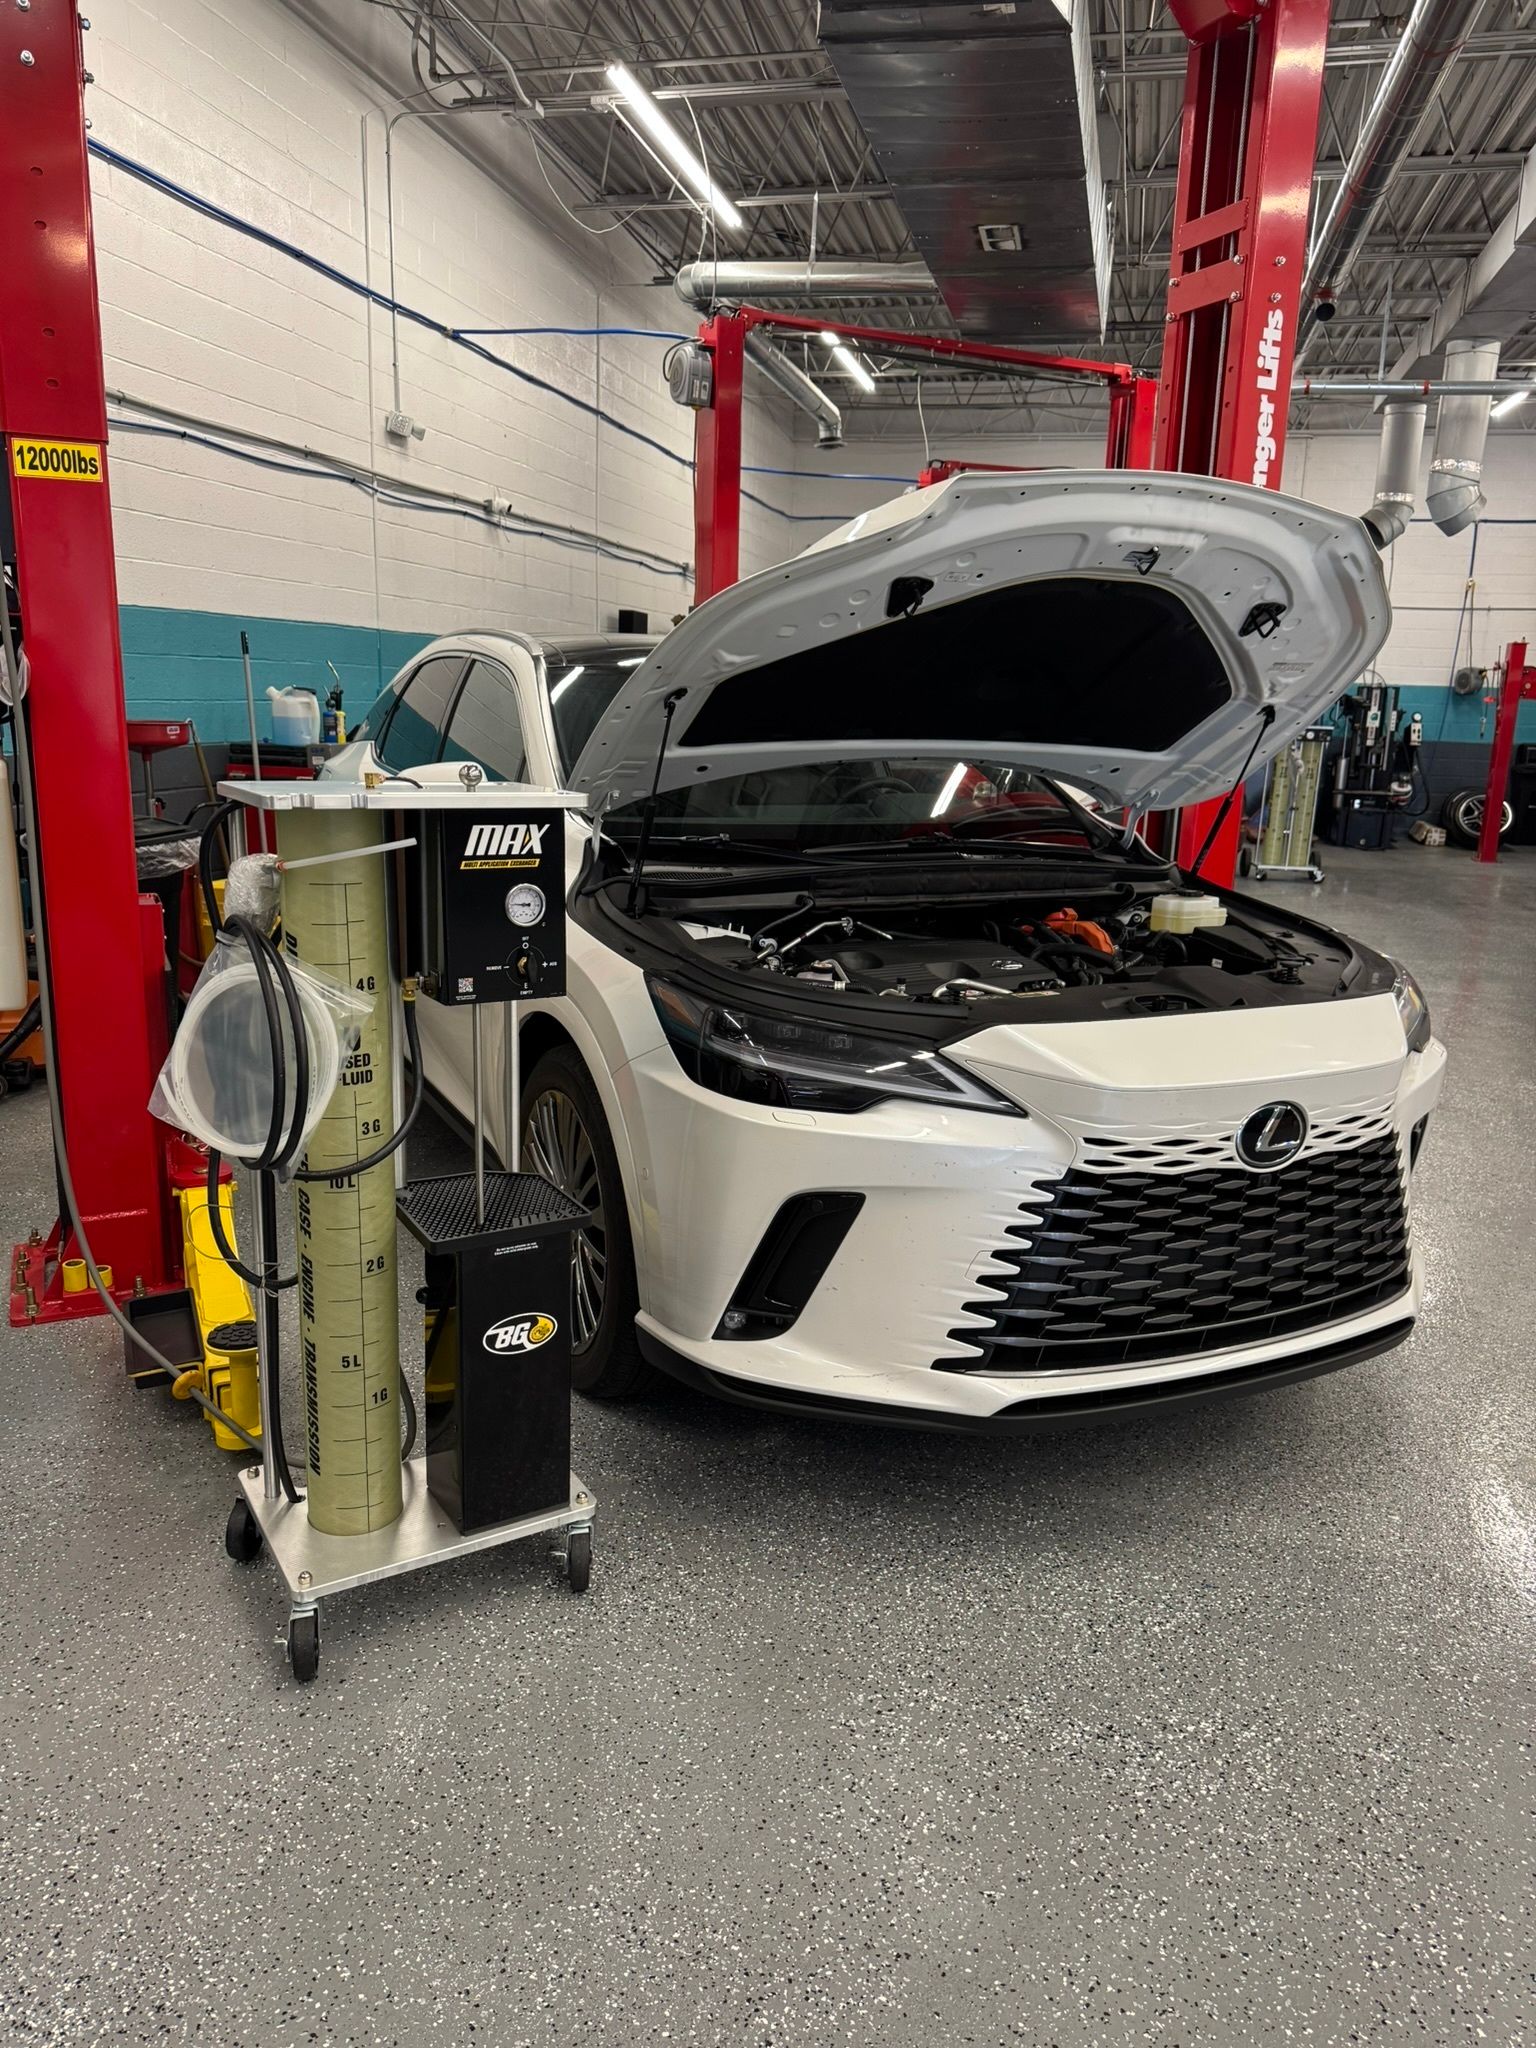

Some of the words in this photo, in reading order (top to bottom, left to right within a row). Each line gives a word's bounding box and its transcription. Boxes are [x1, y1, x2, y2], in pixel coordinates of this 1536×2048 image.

[1257, 309, 1284, 391] Lifts
[16, 445, 99, 475] 12000lbs
[464, 824, 551, 856] MAX
[298, 1187, 312, 1240] CASE
[301, 1252, 315, 1324] ENGINE
[494, 1322, 532, 1349] BG
[304, 1337, 320, 1476] TRANSMISSION
